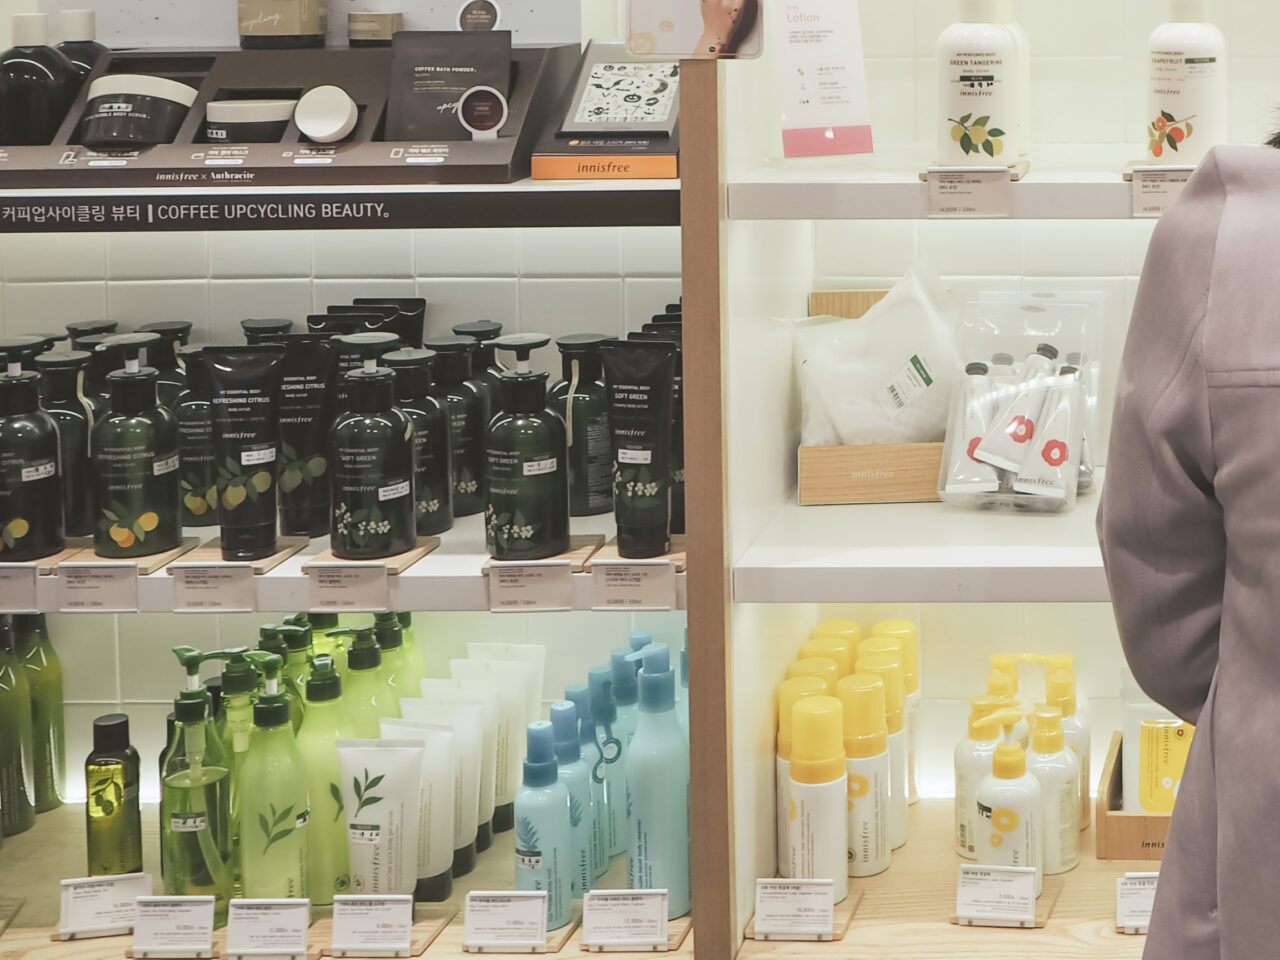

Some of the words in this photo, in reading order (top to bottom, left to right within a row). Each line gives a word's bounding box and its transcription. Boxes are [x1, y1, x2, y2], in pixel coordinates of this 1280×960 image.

[787, 13, 820, 23] Lotion
[970, 58, 1003, 66] TANGERINE
[960, 88, 994, 97] innisfree
[577, 162, 630, 173] innisfree
[155, 172, 199, 181] innisfree
[210, 170, 255, 180] Anthracite
[2, 204, 106, 223] 커피업사이클링
[111, 204, 141, 223] 뷰티
[158, 204, 220, 220] COFFEE
[225, 202, 316, 219] UPCYCLING
[305, 382, 326, 390] CITRUS
[247, 396, 271, 404] CITRUS
[615, 392, 628, 400] SOFT
[628, 393, 648, 401] GREEN
[222, 431, 257, 440] innisfree
[614, 428, 647, 437] innisfree
[1016, 476, 1054, 486] innisfree
[860, 820, 869, 863] innisfree
[1141, 841, 1165, 849] innis
[580, 849, 588, 890] innisfree
